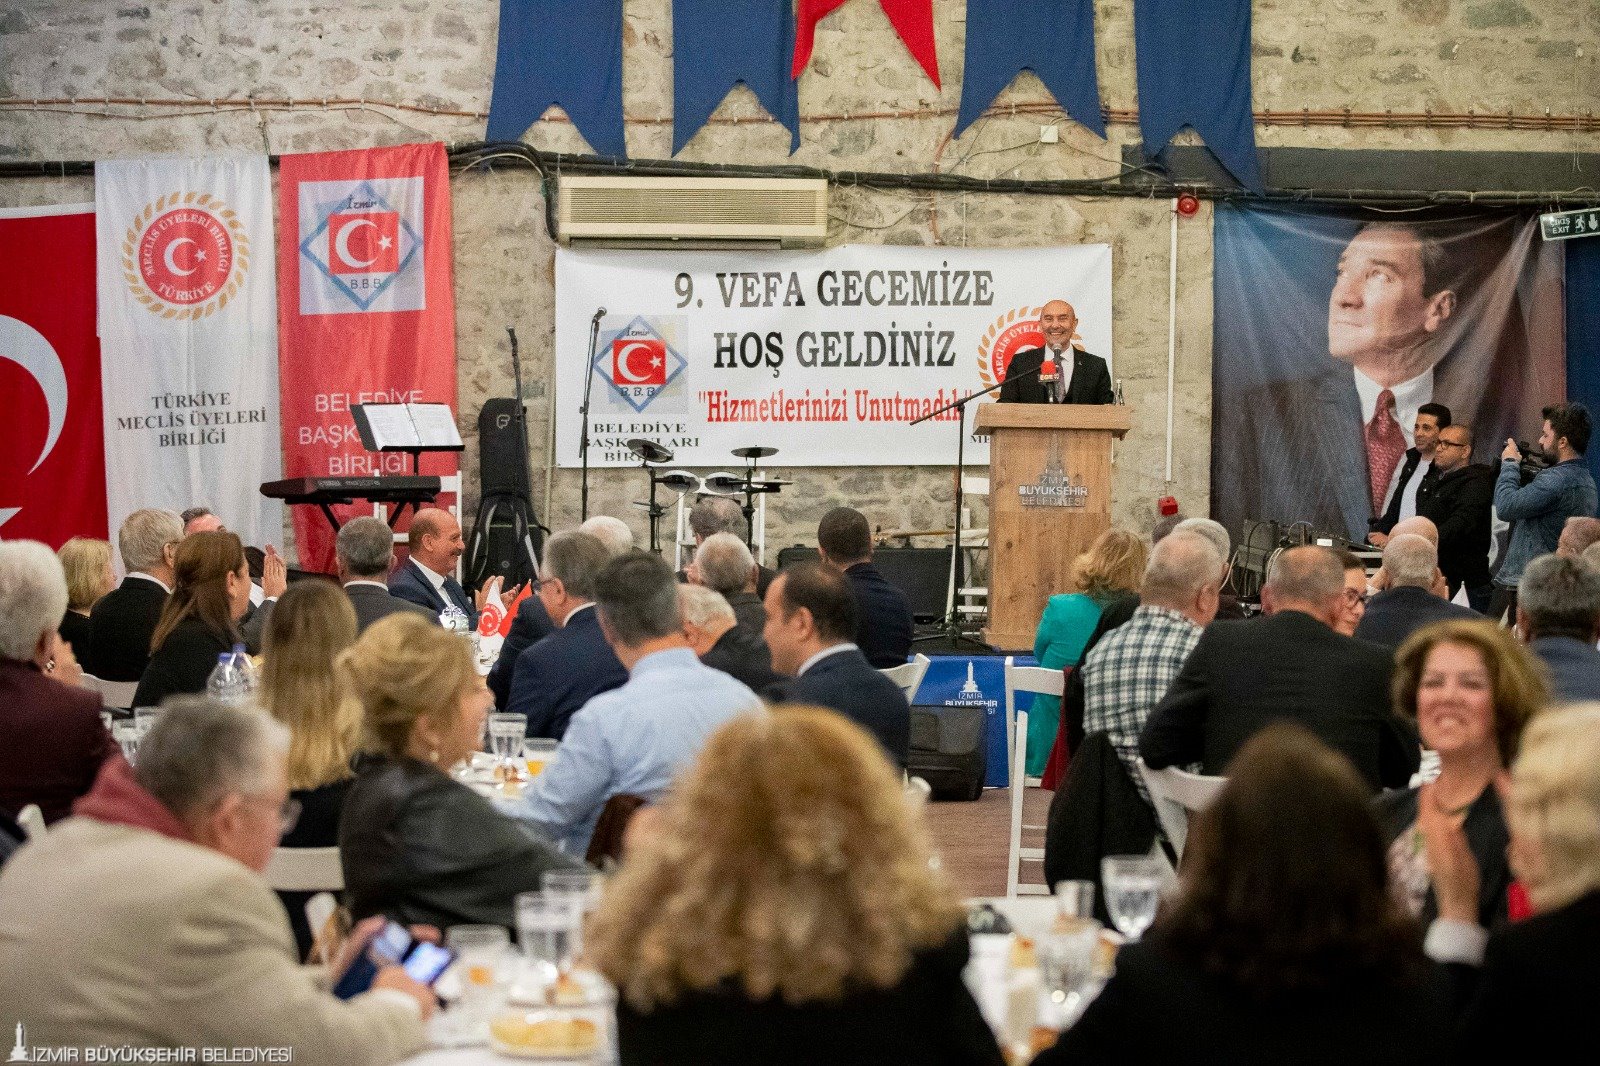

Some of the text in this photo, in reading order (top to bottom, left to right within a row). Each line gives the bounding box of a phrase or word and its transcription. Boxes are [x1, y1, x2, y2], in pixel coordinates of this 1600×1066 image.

[1552, 226, 1570, 234] EXIT
[674, 260, 995, 308] 9. VEFA GECEMİZE
[713, 321, 957, 379] HOŞ GELDİNİZ
[151, 391, 231, 409] TÜRKİYE
[117, 406, 267, 431] MECLİS ÜYELERİ
[594, 421, 687, 433] BELEDİYE
[159, 427, 226, 447] BİRLİĞİ
